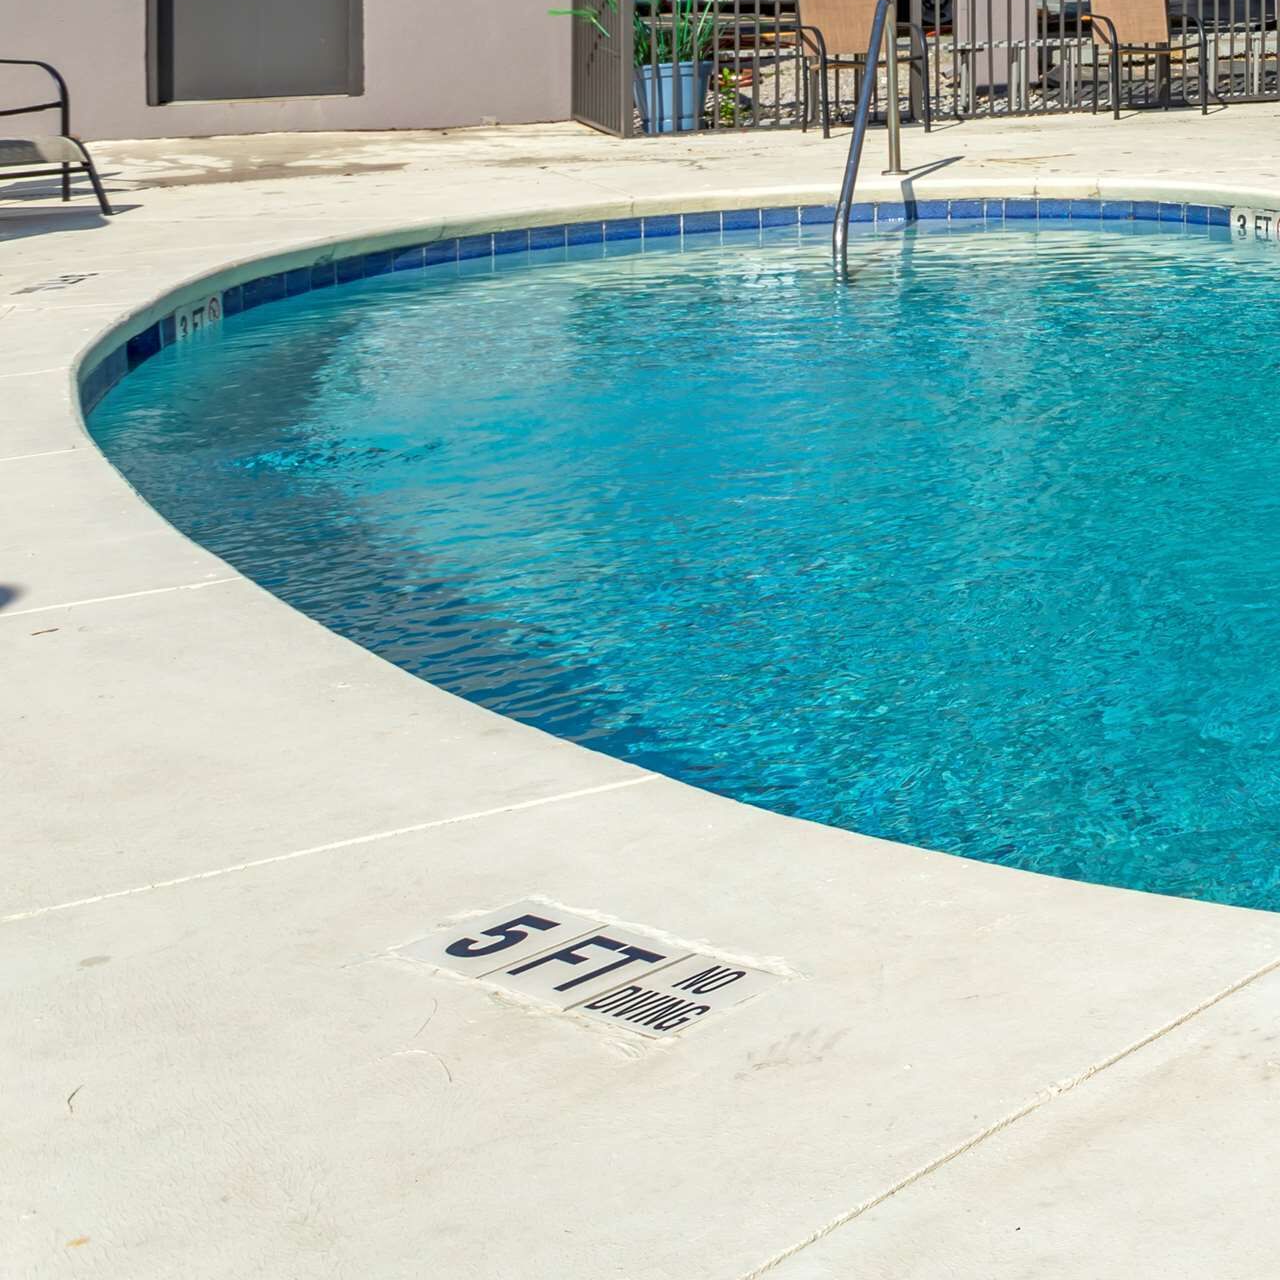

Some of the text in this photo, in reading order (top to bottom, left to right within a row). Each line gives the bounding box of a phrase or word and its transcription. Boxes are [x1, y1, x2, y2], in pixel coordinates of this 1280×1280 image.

[1254, 215, 1273, 233] FT
[445, 914, 667, 992] 5 FT
[671, 965, 747, 995] NO
[583, 985, 712, 1032] DIVING
